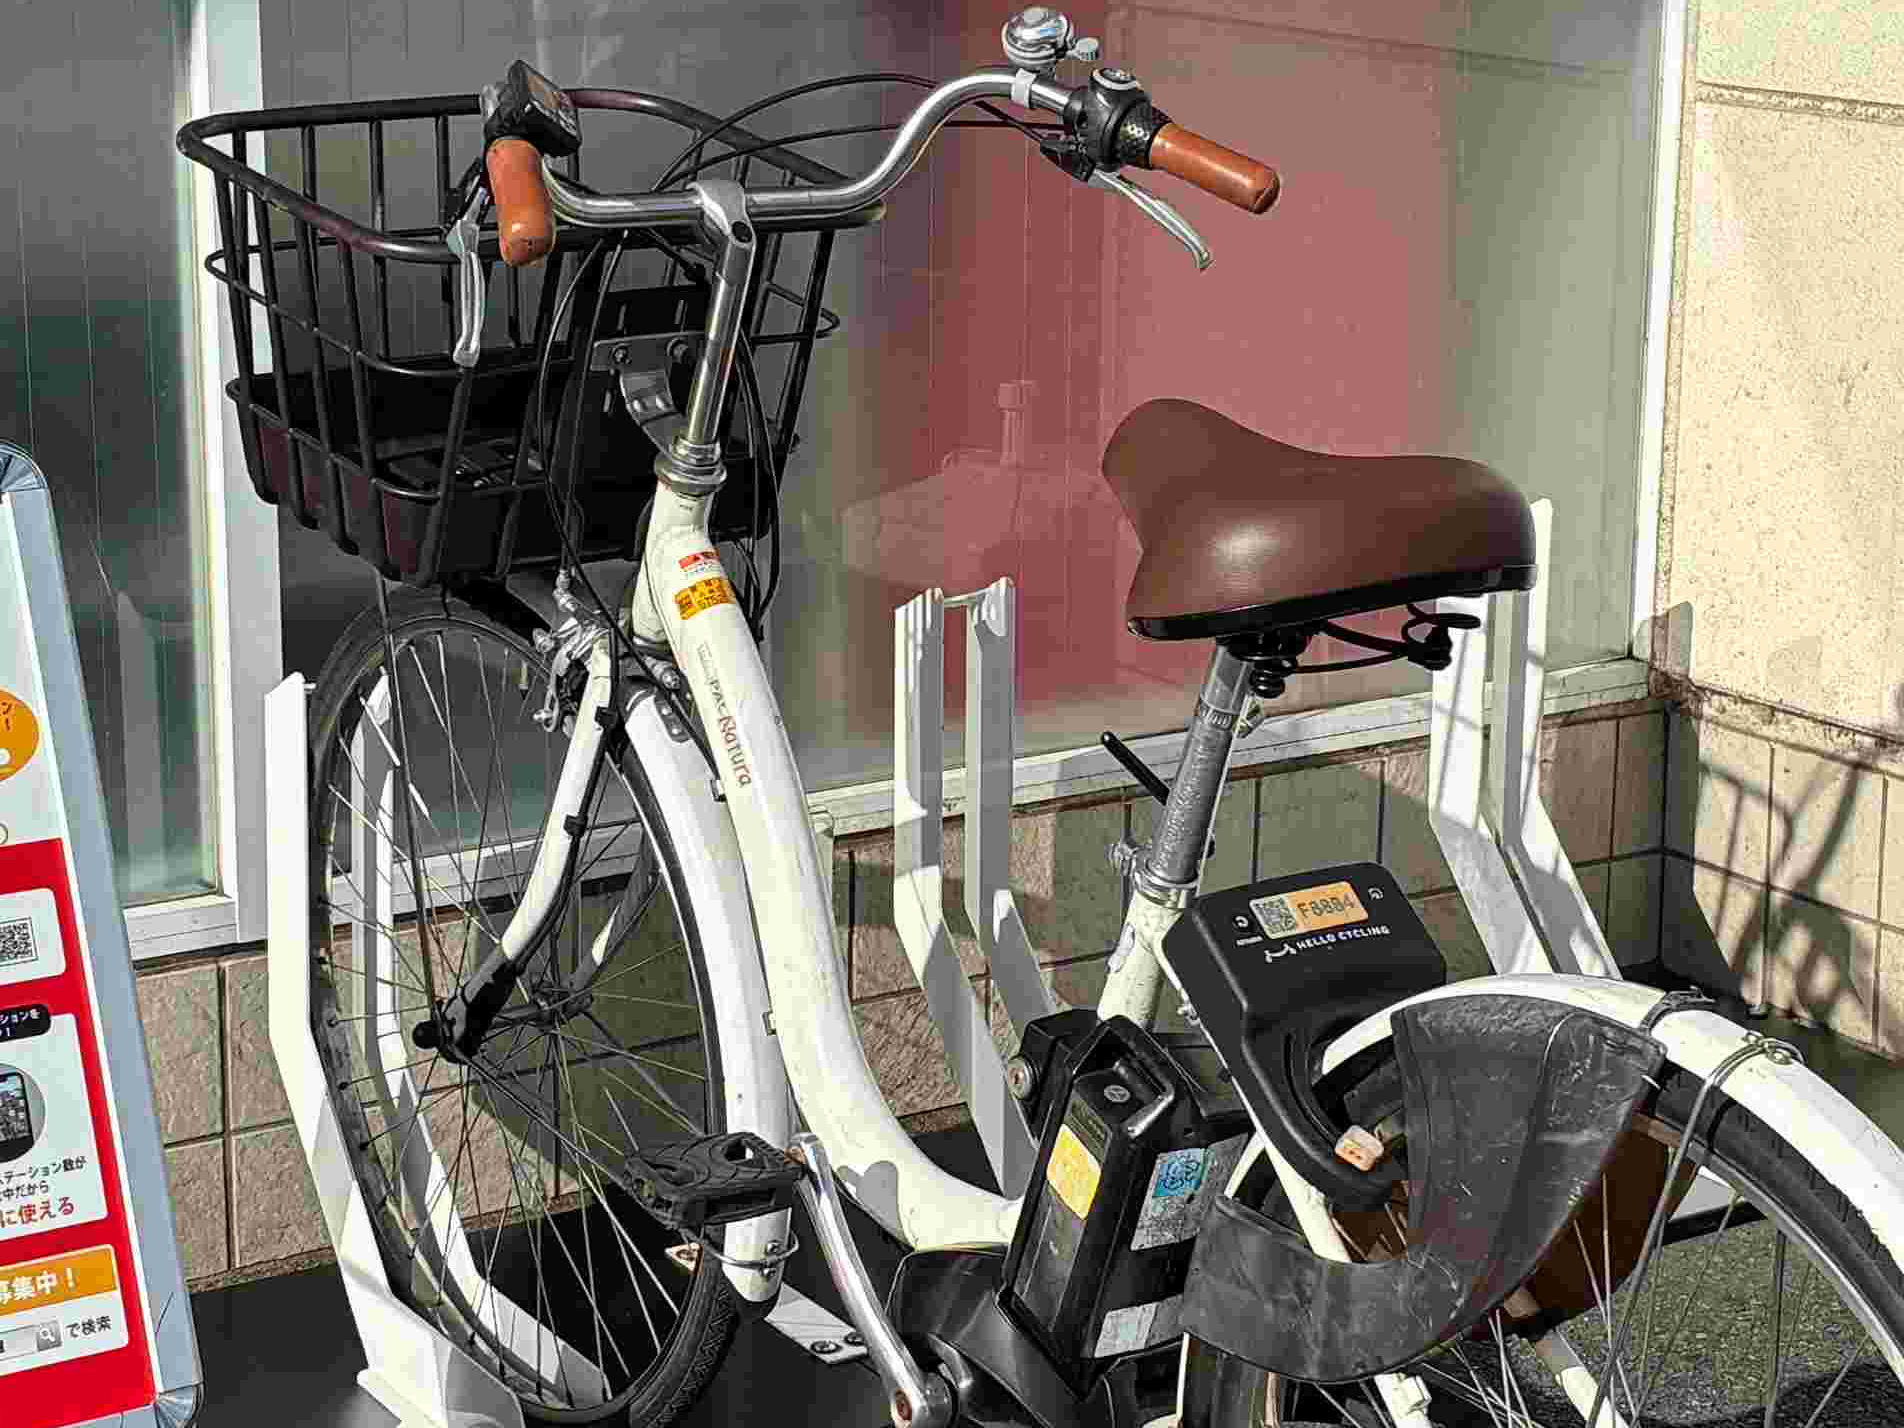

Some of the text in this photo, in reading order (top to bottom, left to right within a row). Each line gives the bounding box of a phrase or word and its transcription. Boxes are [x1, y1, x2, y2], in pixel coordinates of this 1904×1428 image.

[1296, 933, 1337, 950] HELLO
[66, 1314, 112, 1340] で検索
